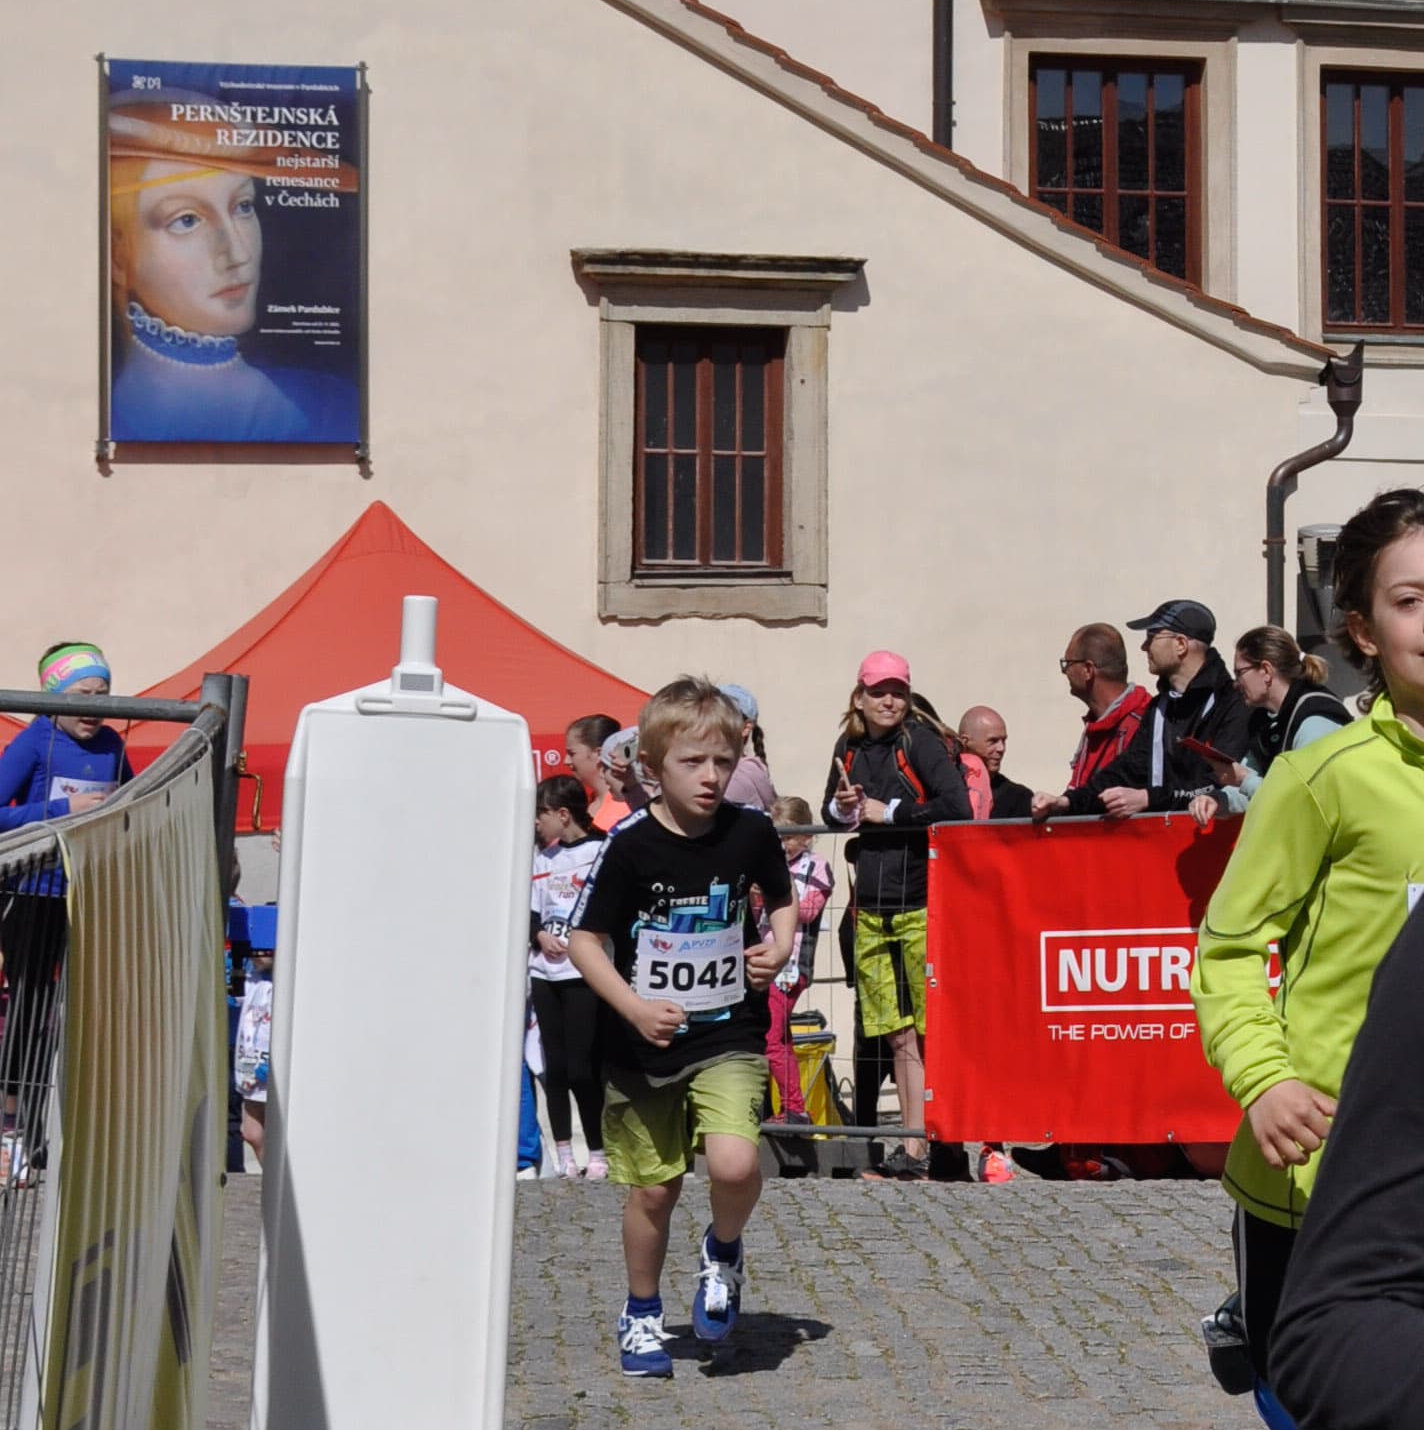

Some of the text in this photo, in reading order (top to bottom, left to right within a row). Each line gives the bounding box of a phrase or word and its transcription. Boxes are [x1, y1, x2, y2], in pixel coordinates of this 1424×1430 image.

[170, 101, 340, 126] PERNŠTEJNSKÁ
[216, 128, 340, 149] REZIDENCE
[276, 154, 340, 171] nejstarší
[265, 174, 340, 188] renesance
[264, 190, 340, 208] v Čechách
[648, 955, 738, 991] 5042
[1048, 1023, 1196, 1041] THE POWER OF
